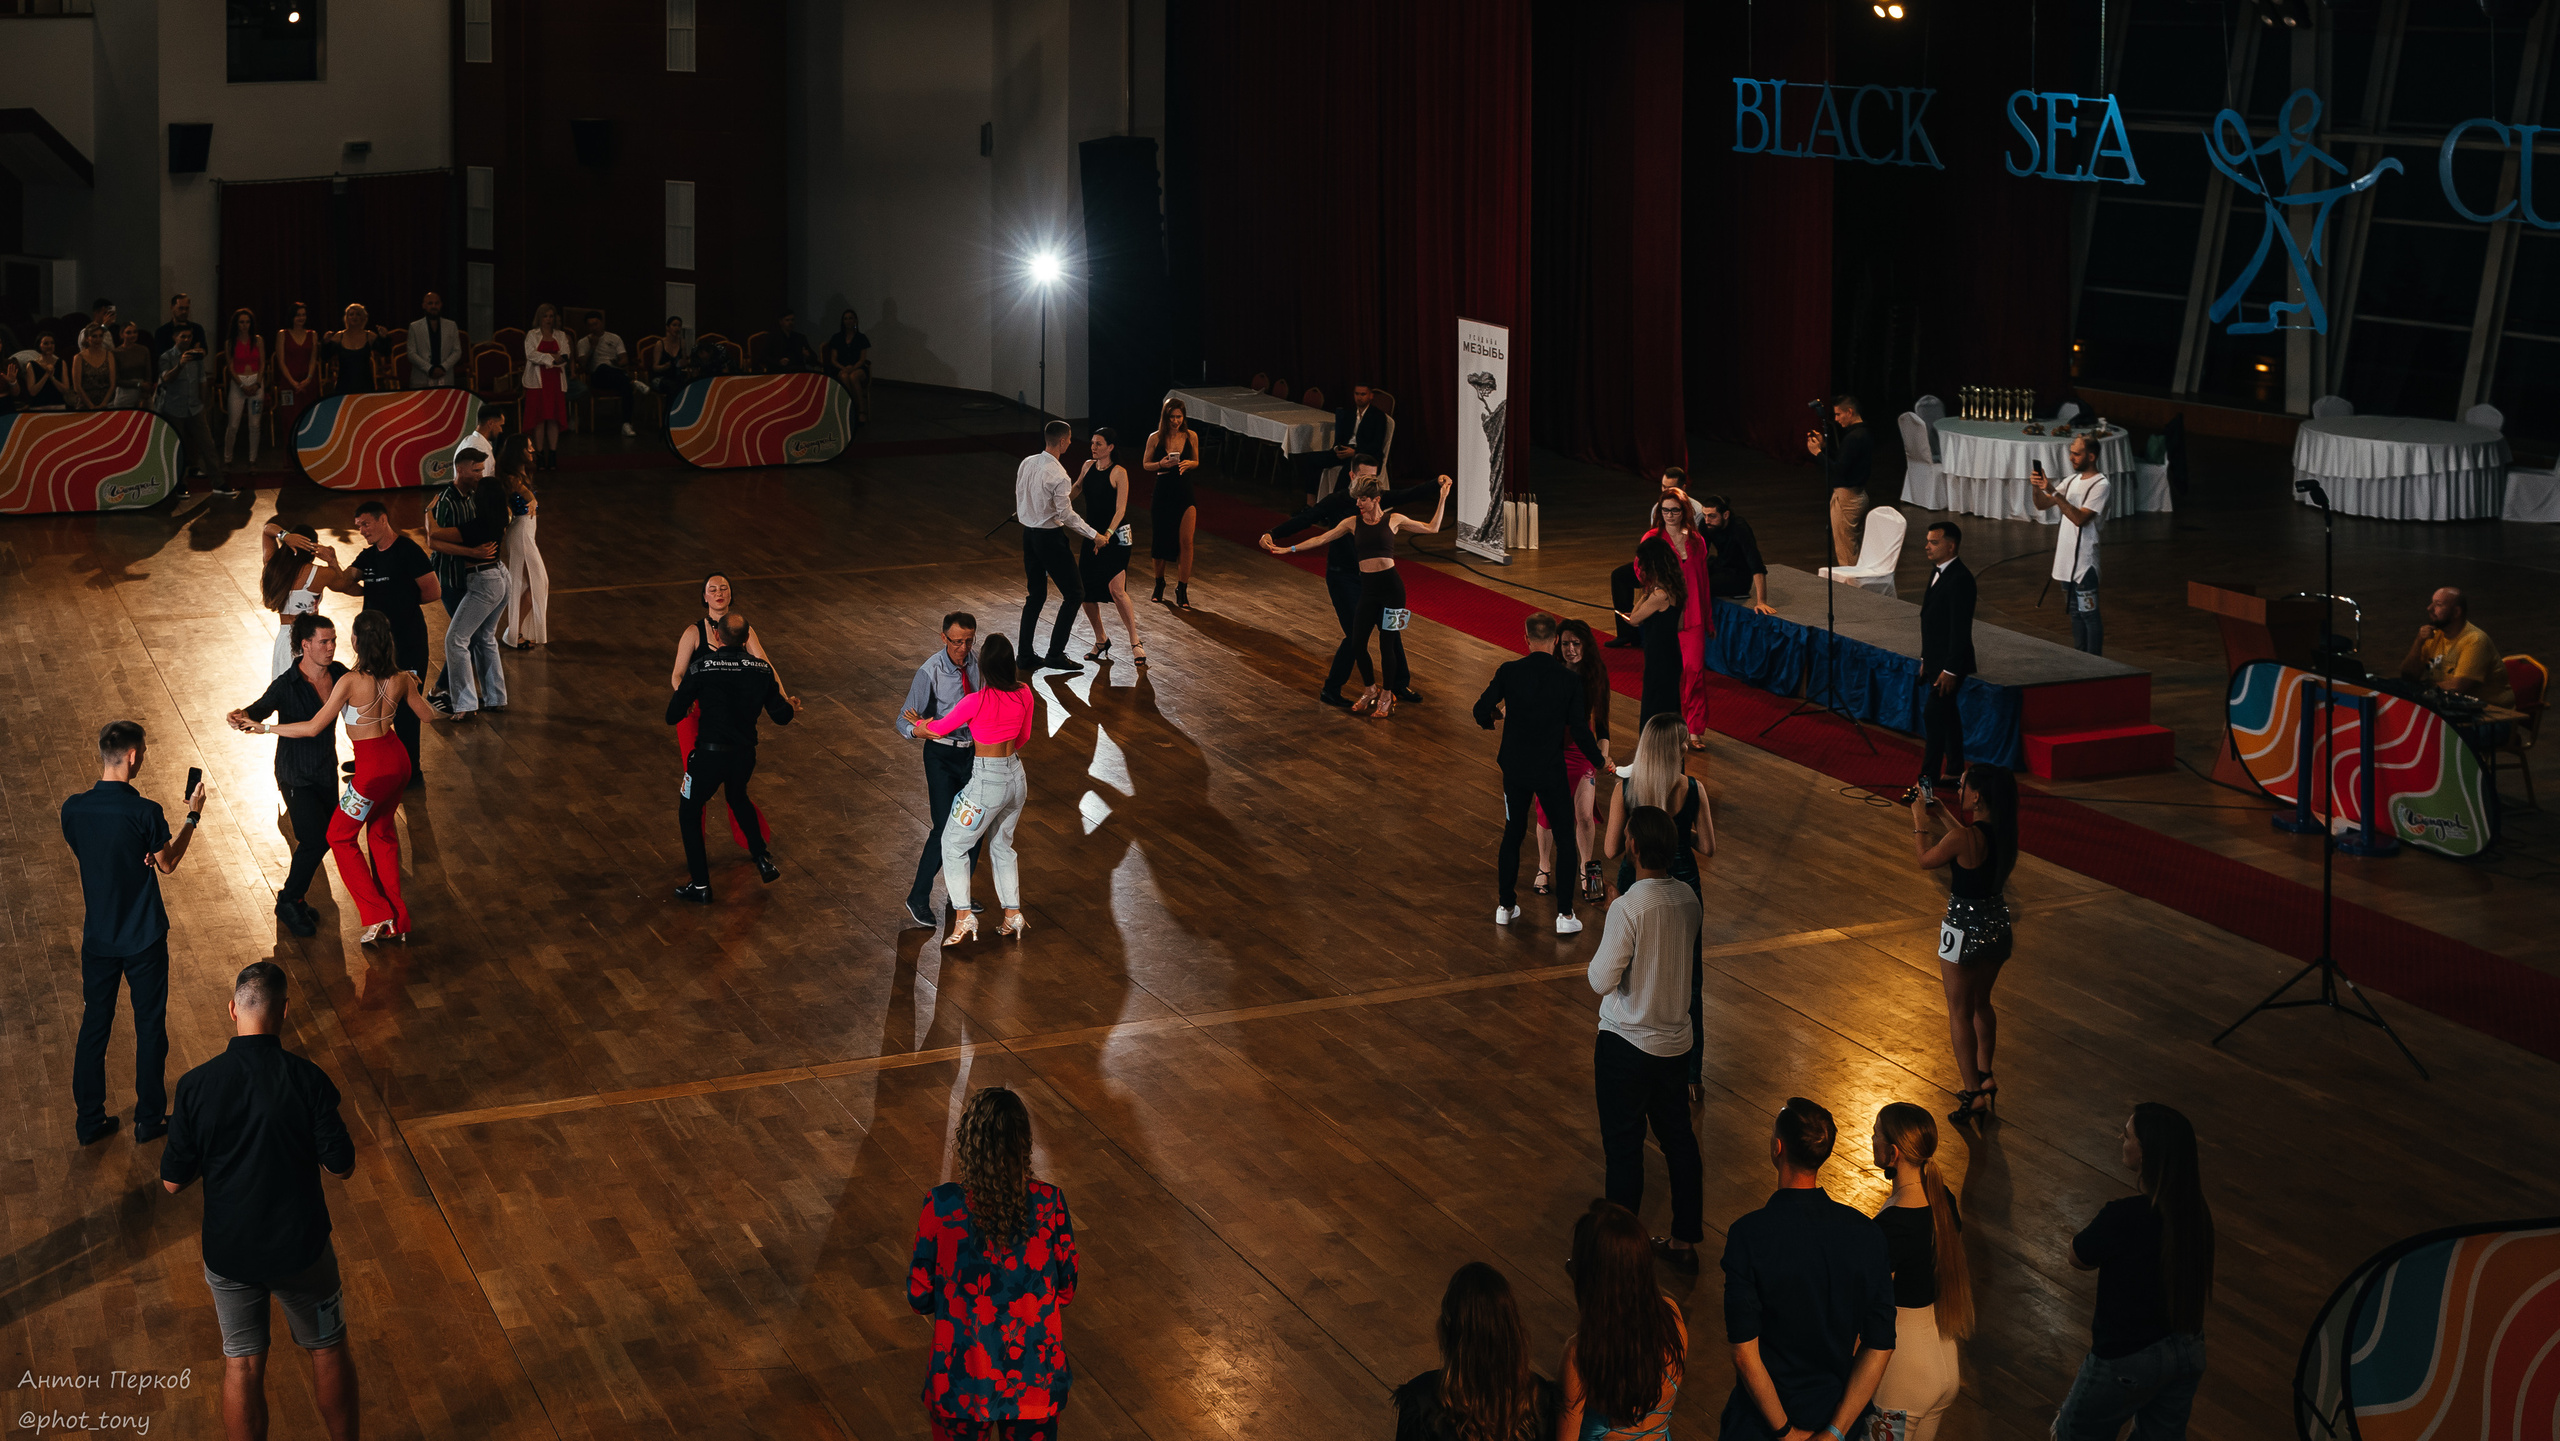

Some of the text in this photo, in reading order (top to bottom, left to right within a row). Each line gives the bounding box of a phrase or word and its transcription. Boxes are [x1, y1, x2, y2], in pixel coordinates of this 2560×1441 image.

[1732, 77, 1945, 170] BLACK
[2005, 89, 2146, 185] SEA
[1463, 340, 1505, 360] МЕЗЫБЬ
[1387, 615, 1405, 629] 25
[341, 795, 362, 817] 45
[951, 800, 975, 827] 36
[1940, 930, 1956, 954] 9
